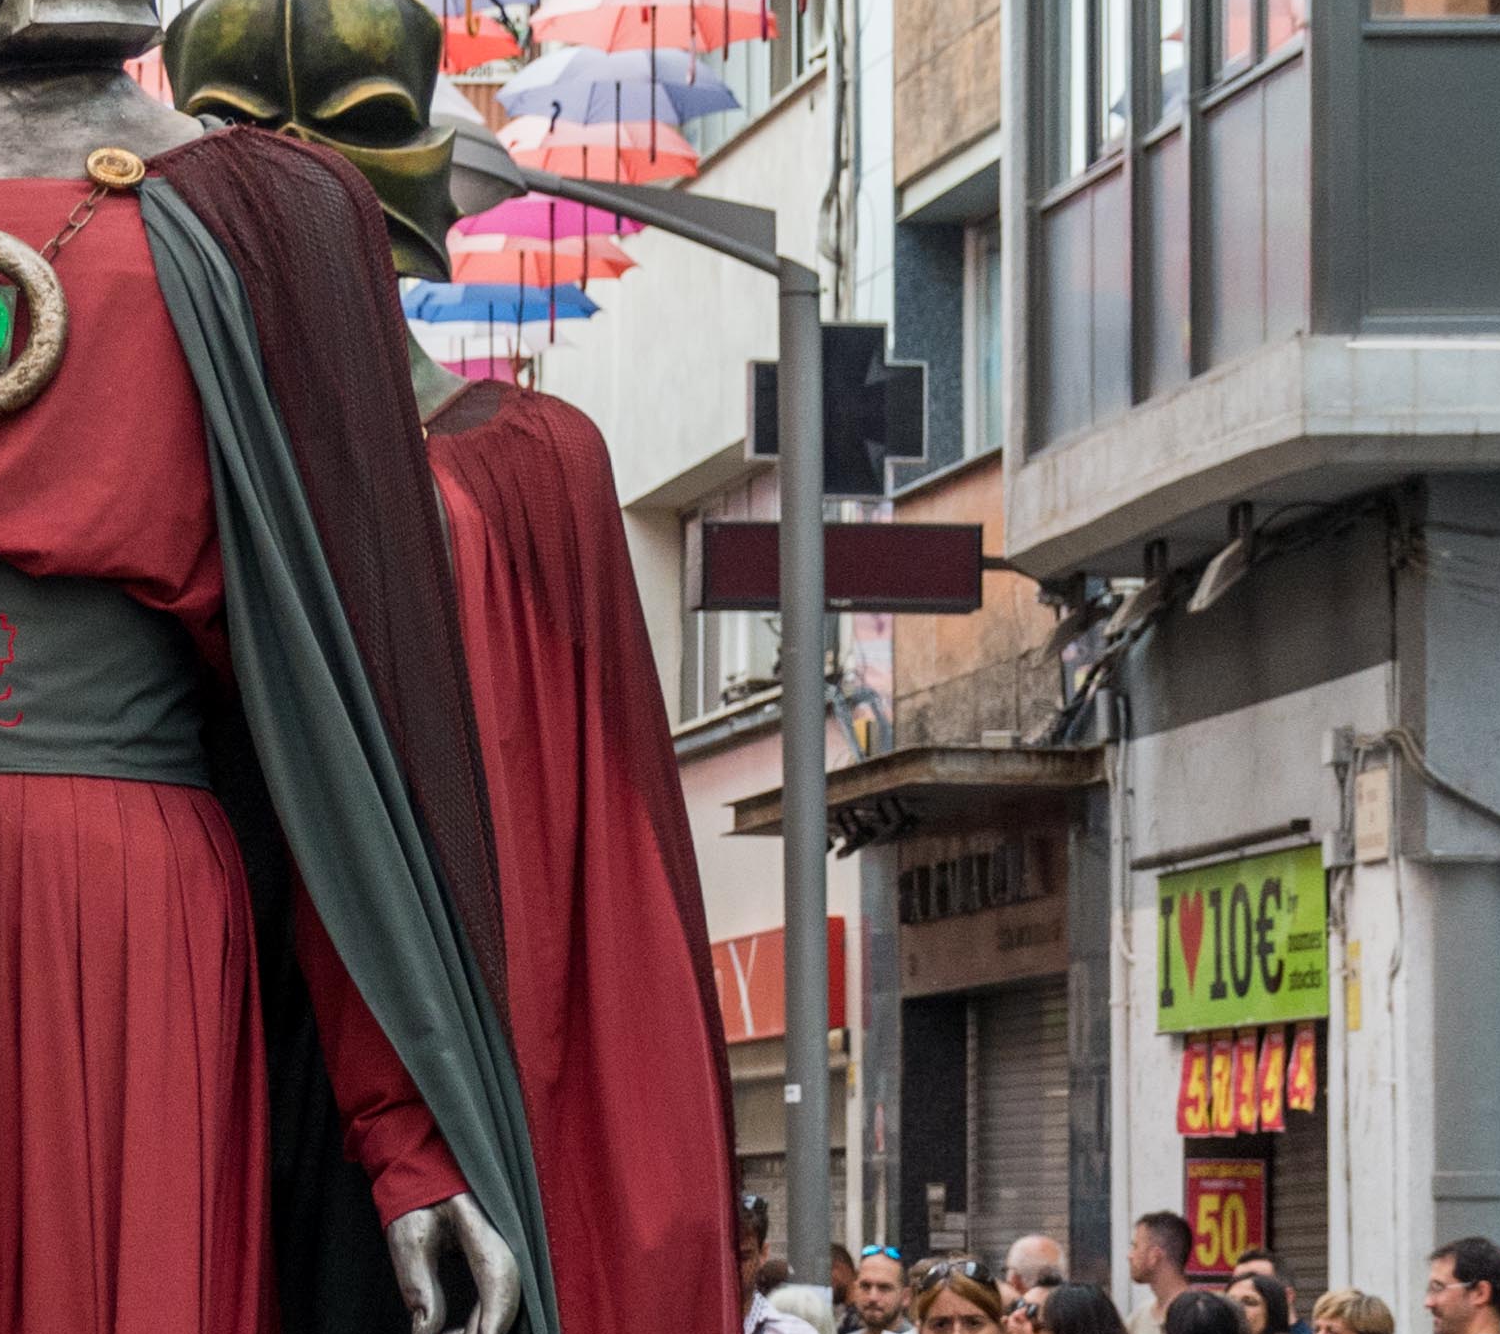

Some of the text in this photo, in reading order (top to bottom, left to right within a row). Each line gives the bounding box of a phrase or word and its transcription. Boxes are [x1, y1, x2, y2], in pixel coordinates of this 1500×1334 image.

[1160, 896, 1174, 1008] I
[1209, 878, 1285, 998] 10€
[1196, 1193, 1262, 1267] 50
